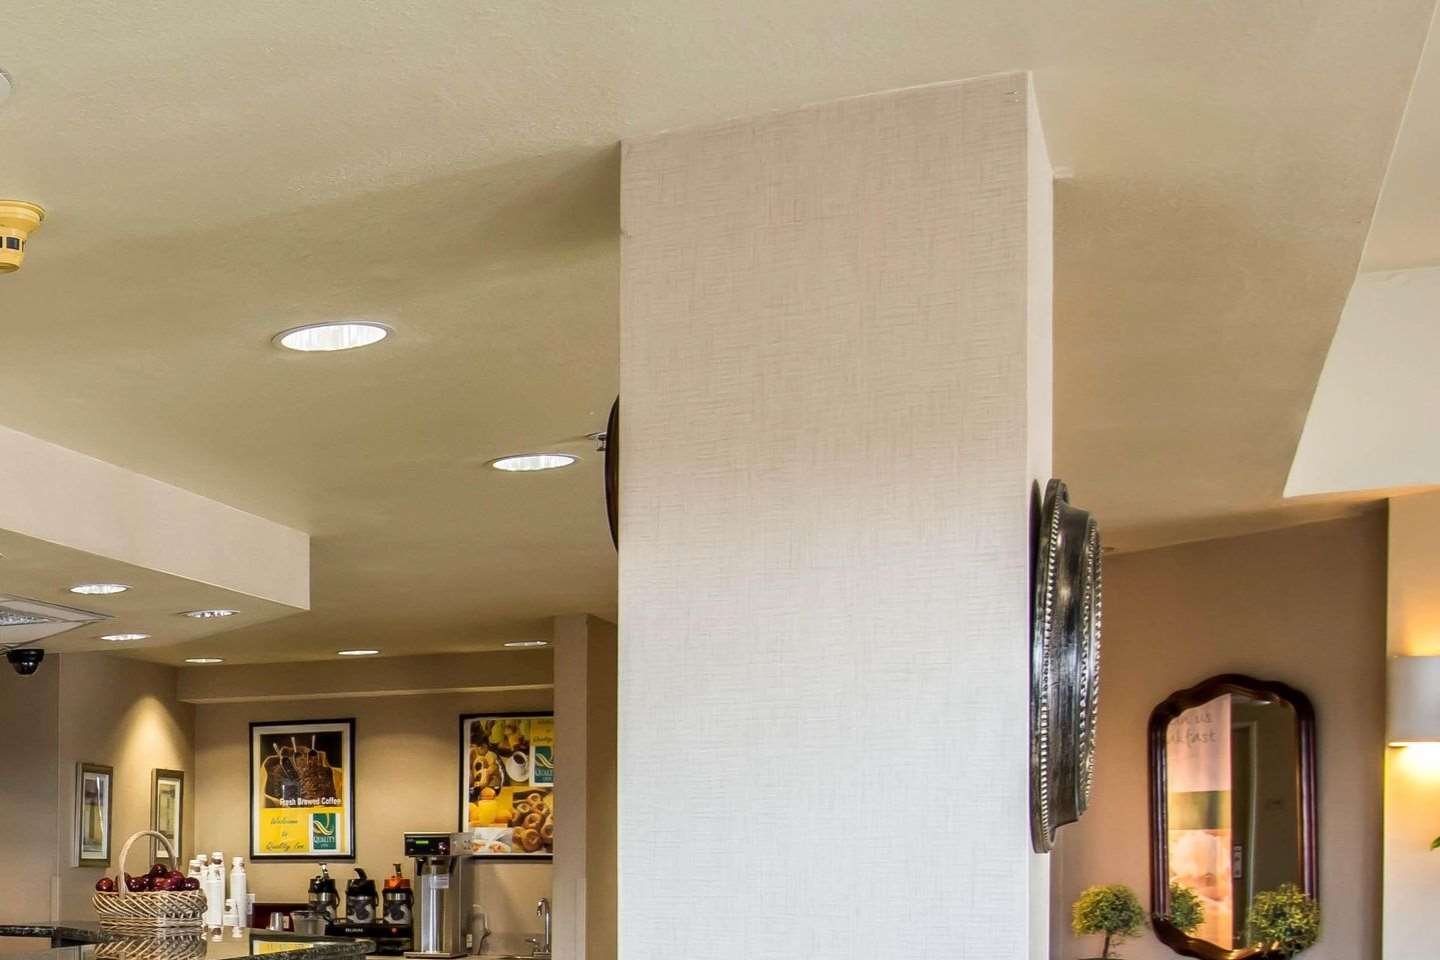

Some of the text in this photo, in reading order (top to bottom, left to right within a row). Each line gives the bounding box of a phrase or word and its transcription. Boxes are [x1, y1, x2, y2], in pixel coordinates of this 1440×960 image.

[297, 797, 320, 805] Brewed
[321, 797, 341, 805] Coffee
[313, 836, 335, 844] QUALITY
